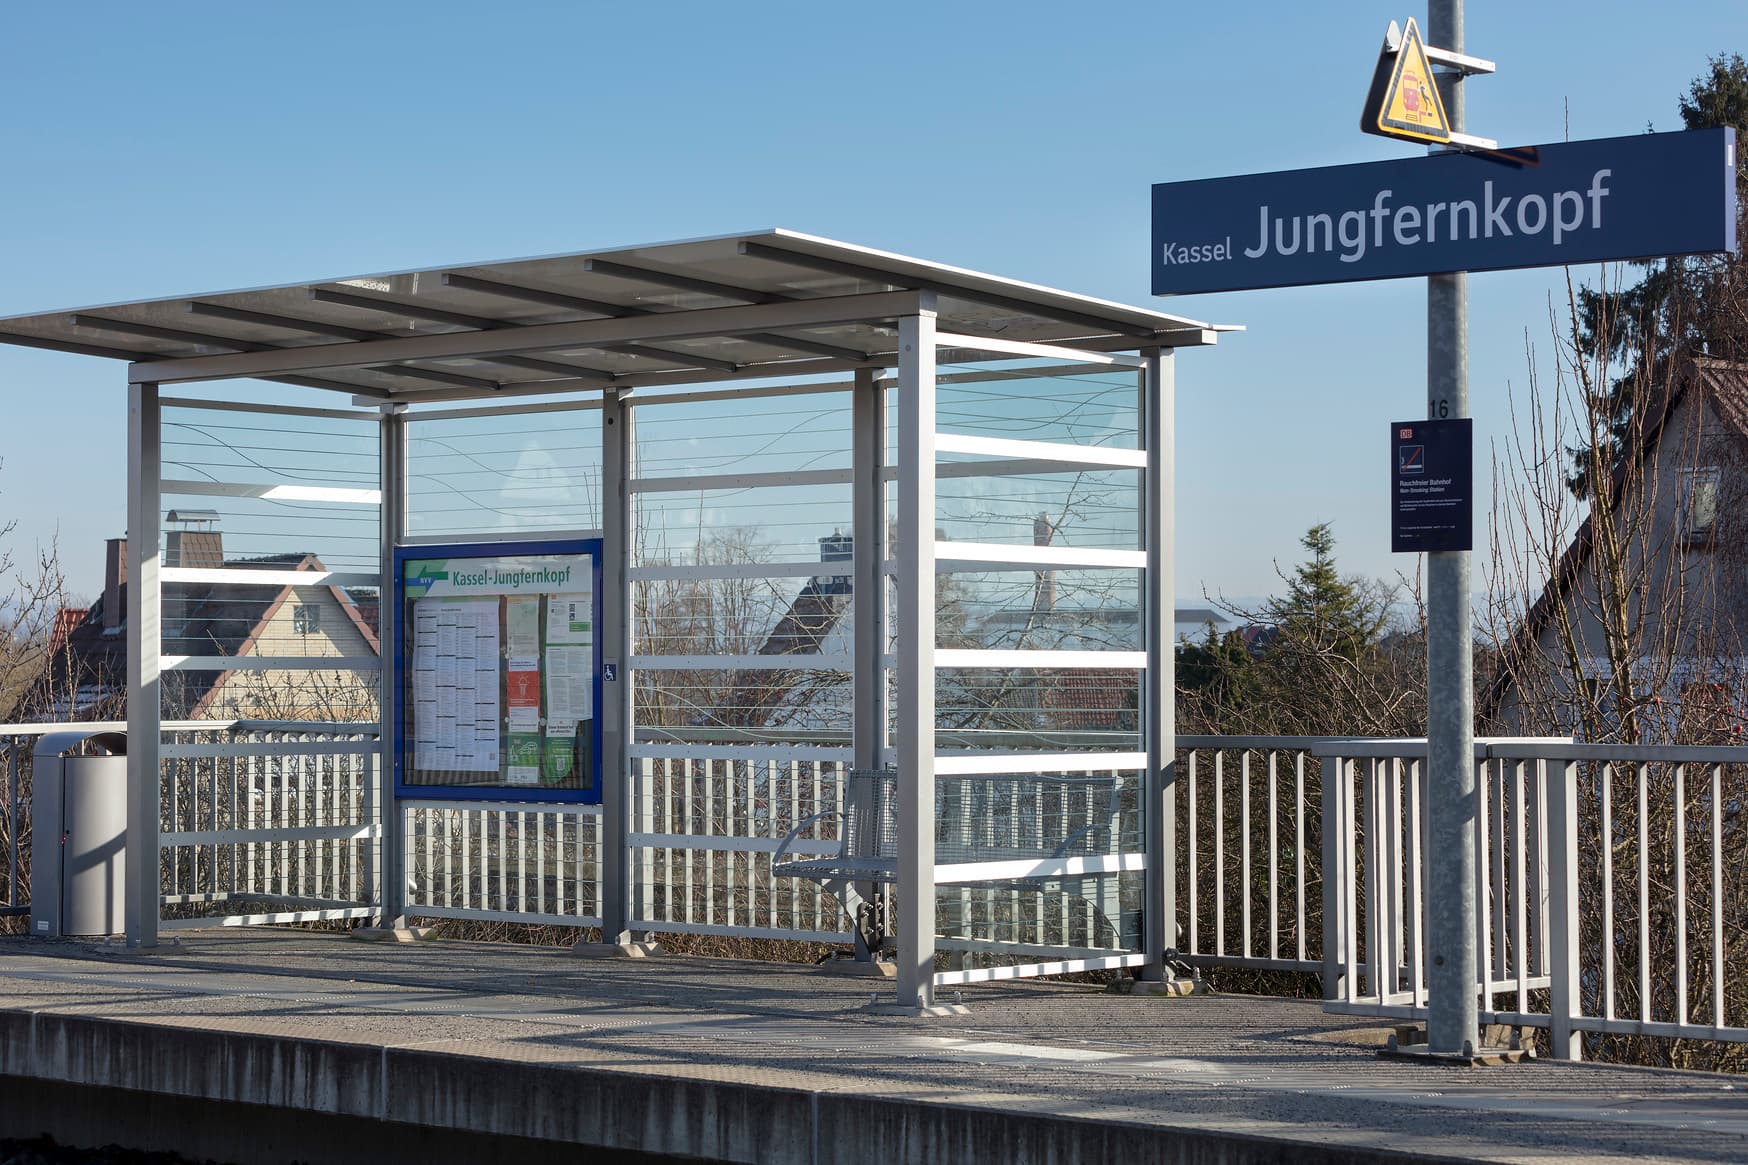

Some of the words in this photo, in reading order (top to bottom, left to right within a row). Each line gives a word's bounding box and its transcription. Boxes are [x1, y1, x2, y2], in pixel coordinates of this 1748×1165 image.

[1163, 236, 1232, 265] Kassel
[1244, 169, 1611, 262] Jungfernkopf
[1430, 399, 1449, 419] 16
[1400, 429, 1412, 438] DB
[1429, 478, 1452, 486] Bahnhof
[453, 566, 570, 587] Kassel-Jungfernkopf
